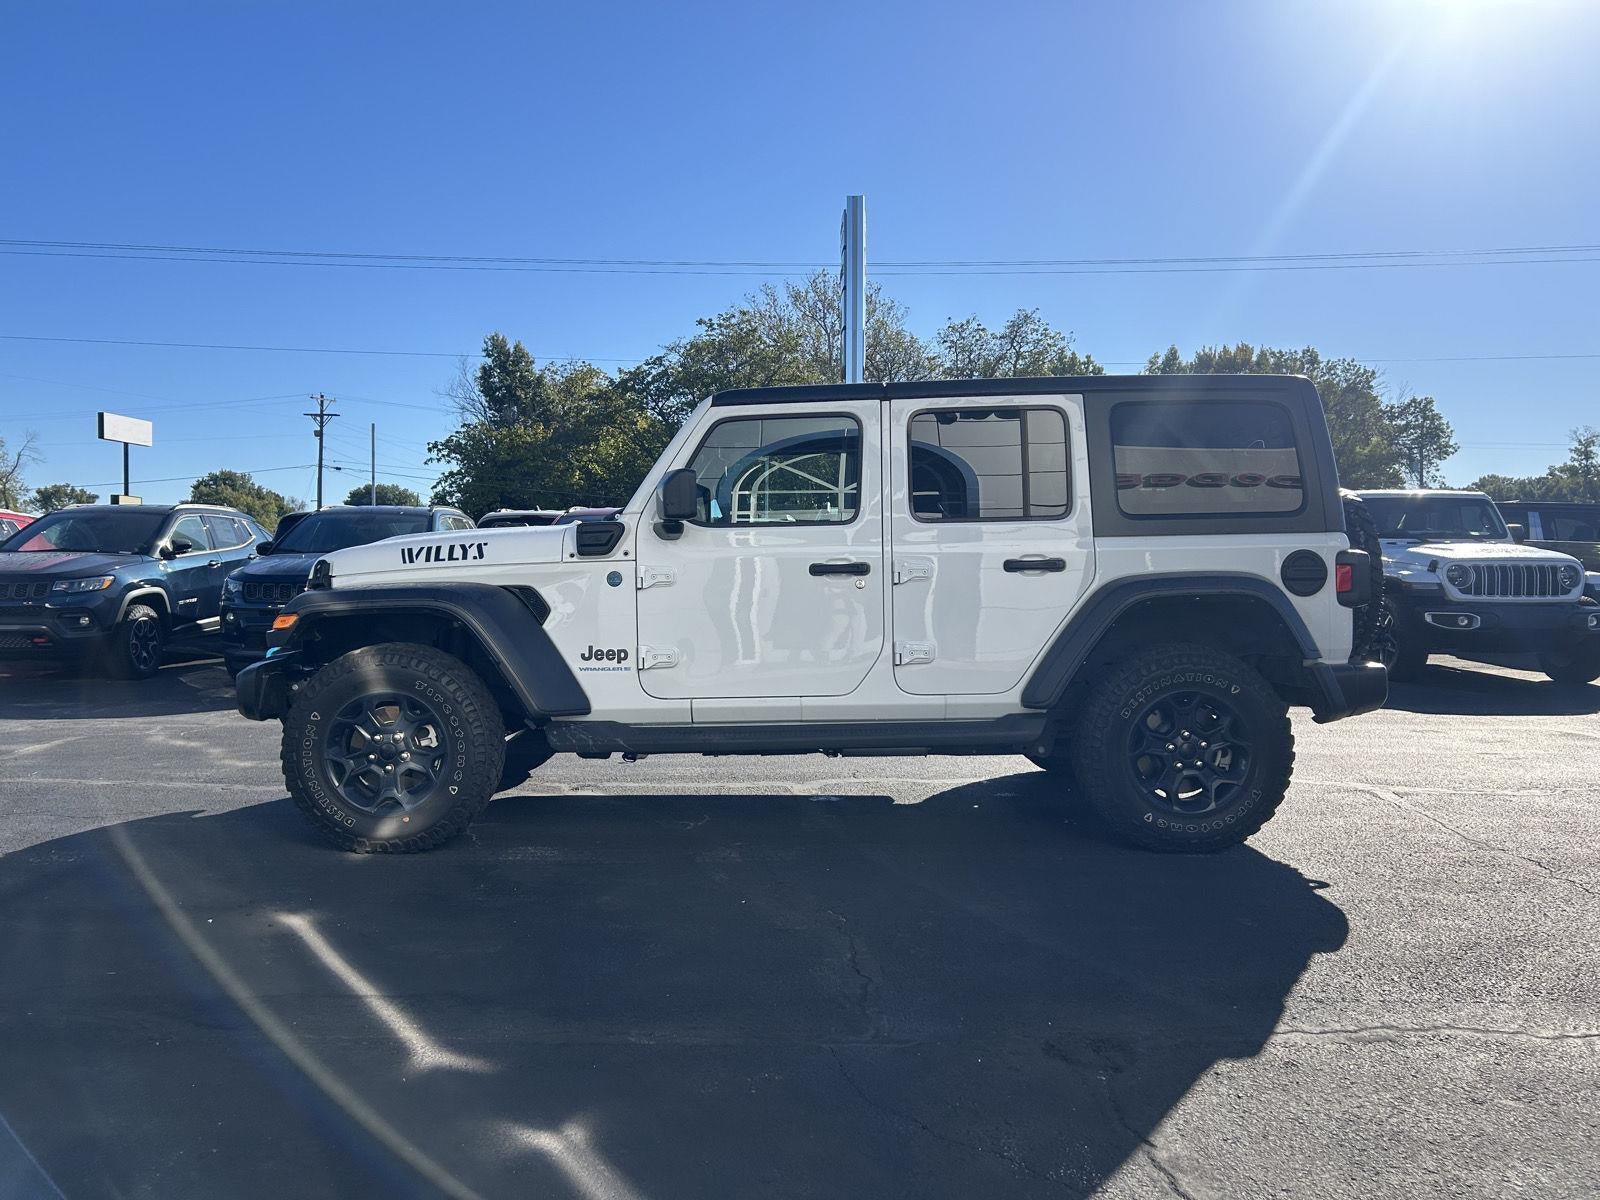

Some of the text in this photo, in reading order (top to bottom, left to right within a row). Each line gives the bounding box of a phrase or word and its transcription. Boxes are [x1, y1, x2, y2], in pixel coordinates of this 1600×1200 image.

[401, 542, 488, 565] WILLYS
[580, 645, 629, 664] Jeep
[1120, 672, 1229, 719] DESTINATION
[302, 724, 356, 828] DESTINATION
